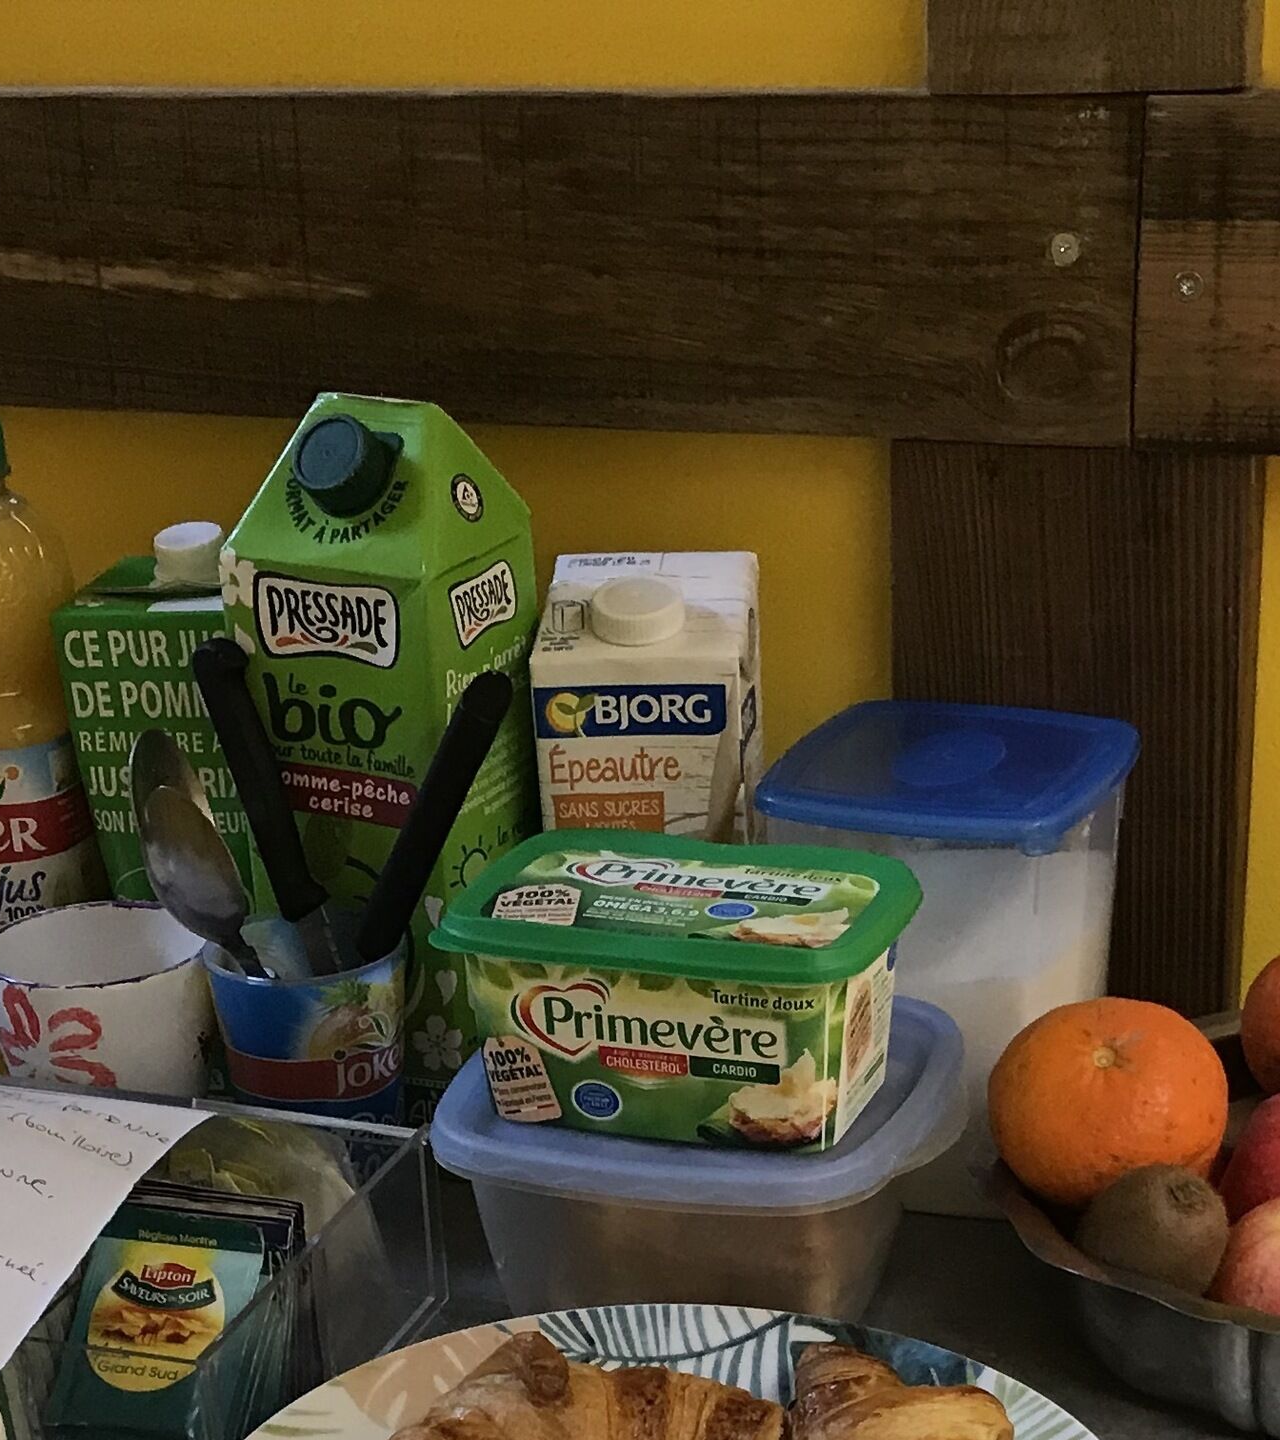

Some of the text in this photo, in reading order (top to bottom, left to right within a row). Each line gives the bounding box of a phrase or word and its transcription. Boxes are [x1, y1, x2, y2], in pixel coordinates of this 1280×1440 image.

[285, 467, 316, 533] ORMAT
[329, 480, 410, 544] PARTAGER
[454, 569, 512, 632] PRESSADE
[266, 584, 389, 648] PRESSADE
[63, 629, 104, 668] CE
[107, 629, 171, 668] PUR
[288, 672, 309, 696] le
[70, 680, 115, 719] DE
[262, 671, 403, 749] bio
[594, 693, 712, 732] BJORG
[299, 743, 343, 765] toute
[346, 745, 363, 768] la
[366, 750, 417, 778] famille
[548, 744, 683, 791] Épeautre
[280, 770, 411, 806] omme-pêche
[308, 795, 374, 818] cerise
[559, 799, 660, 818] SANS SUCRES
[514, 887, 570, 900] 100%
[593, 862, 822, 897] Primevère
[593, 899, 652, 914] OMÉGA
[744, 893, 788, 902] CARDIO
[710, 988, 815, 1012] Tartine doux
[542, 995, 778, 1059] Primevère
[488, 1046, 532, 1068] 100%
[606, 1054, 682, 1075] CHOLESTÉROL
[712, 1063, 757, 1079] CARDIO
[489, 1064, 543, 1083] VÉGÉTAL
[144, 1267, 192, 1284] Lipton
[119, 1276, 211, 1305] SAVEURS SOIR
[97, 1359, 179, 1381] Grand Sud
